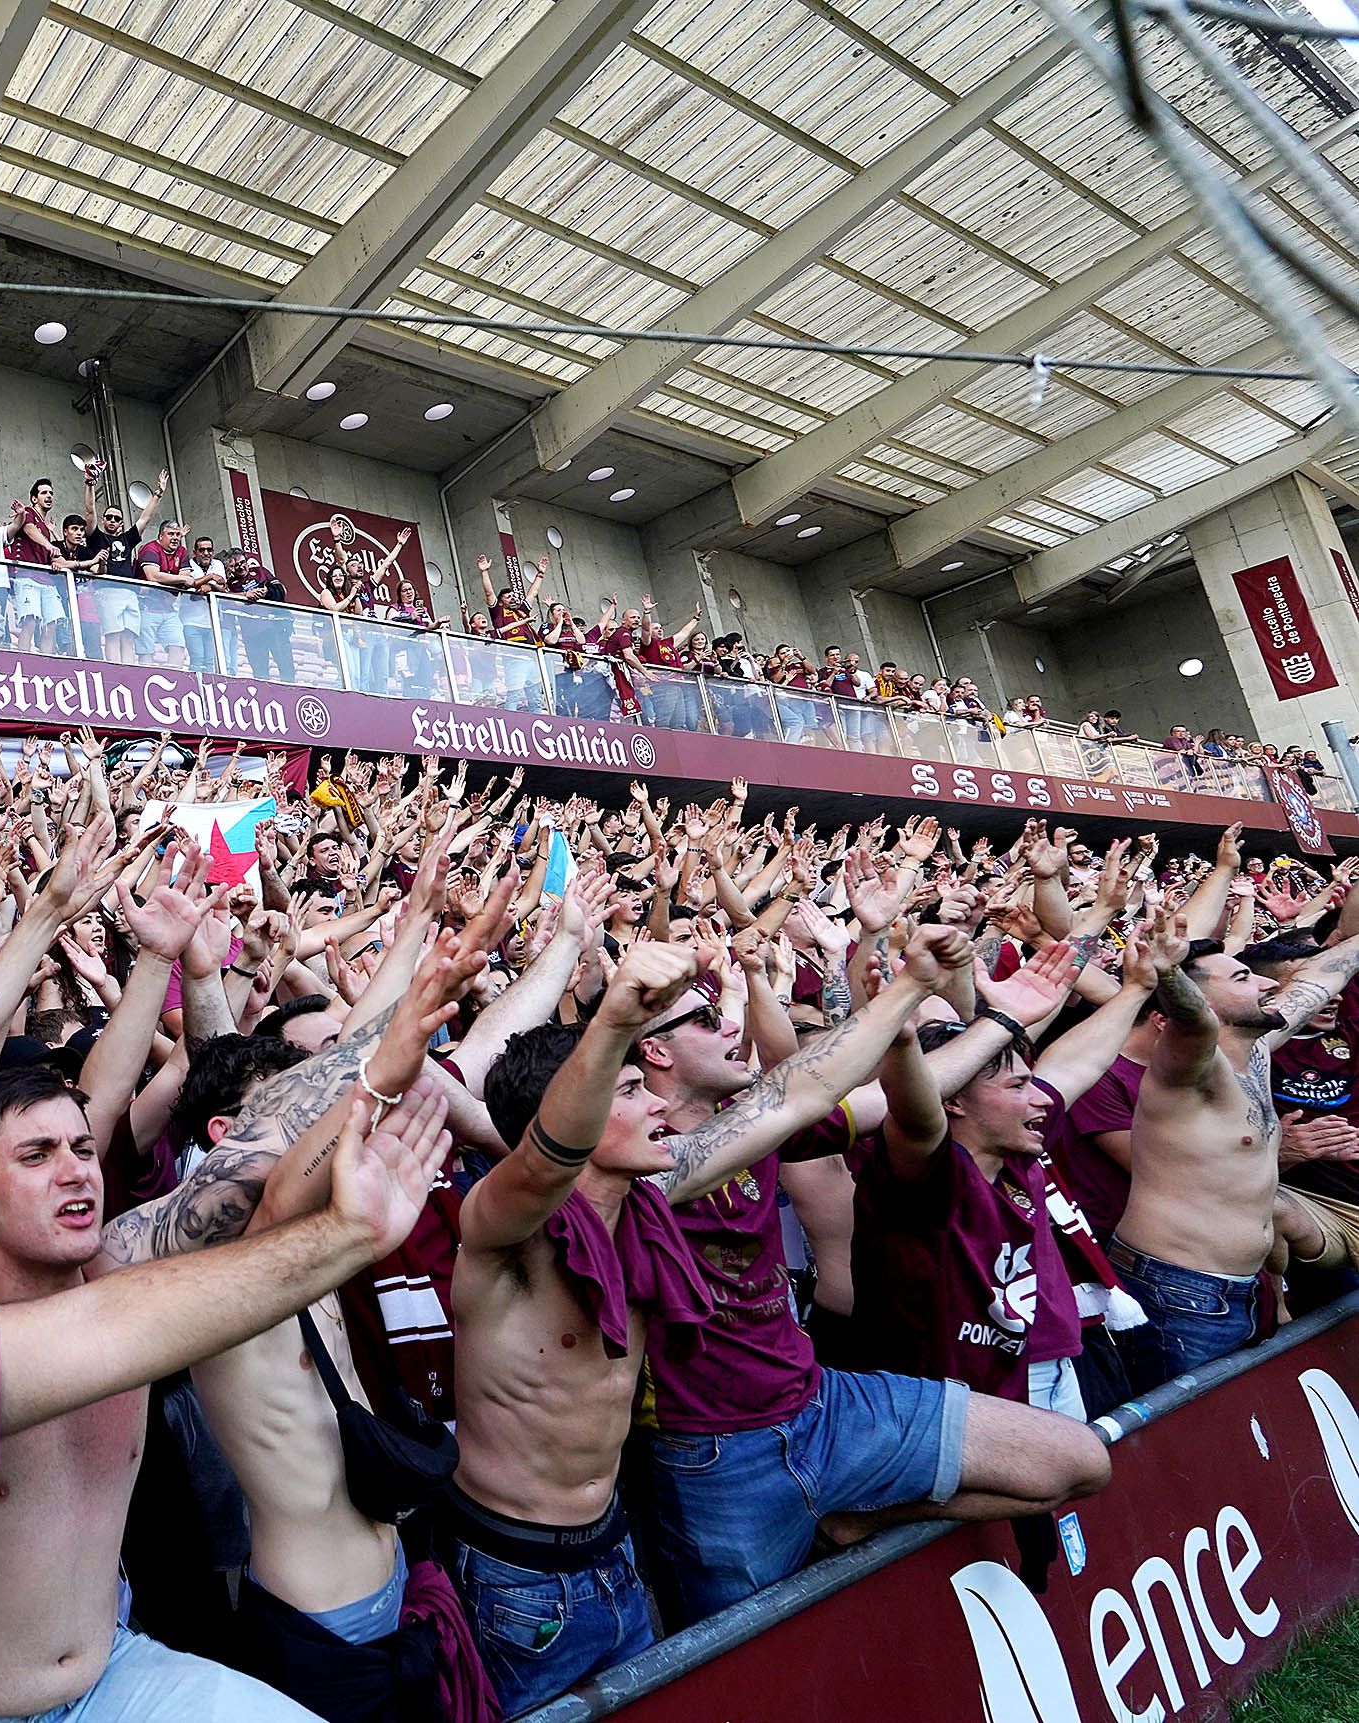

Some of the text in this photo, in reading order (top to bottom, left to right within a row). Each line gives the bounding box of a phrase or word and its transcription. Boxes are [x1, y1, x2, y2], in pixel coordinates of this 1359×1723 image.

[236, 496, 251, 553] Deputación
[244, 498, 259, 554] Pontevedra
[1262, 607, 1286, 649] Concello
[1267, 576, 1302, 644] de Pontevedra
[142, 674, 290, 735] Galicia
[411, 705, 630, 767] Estrella Galicia
[1089, 1505, 1281, 1723] ence
